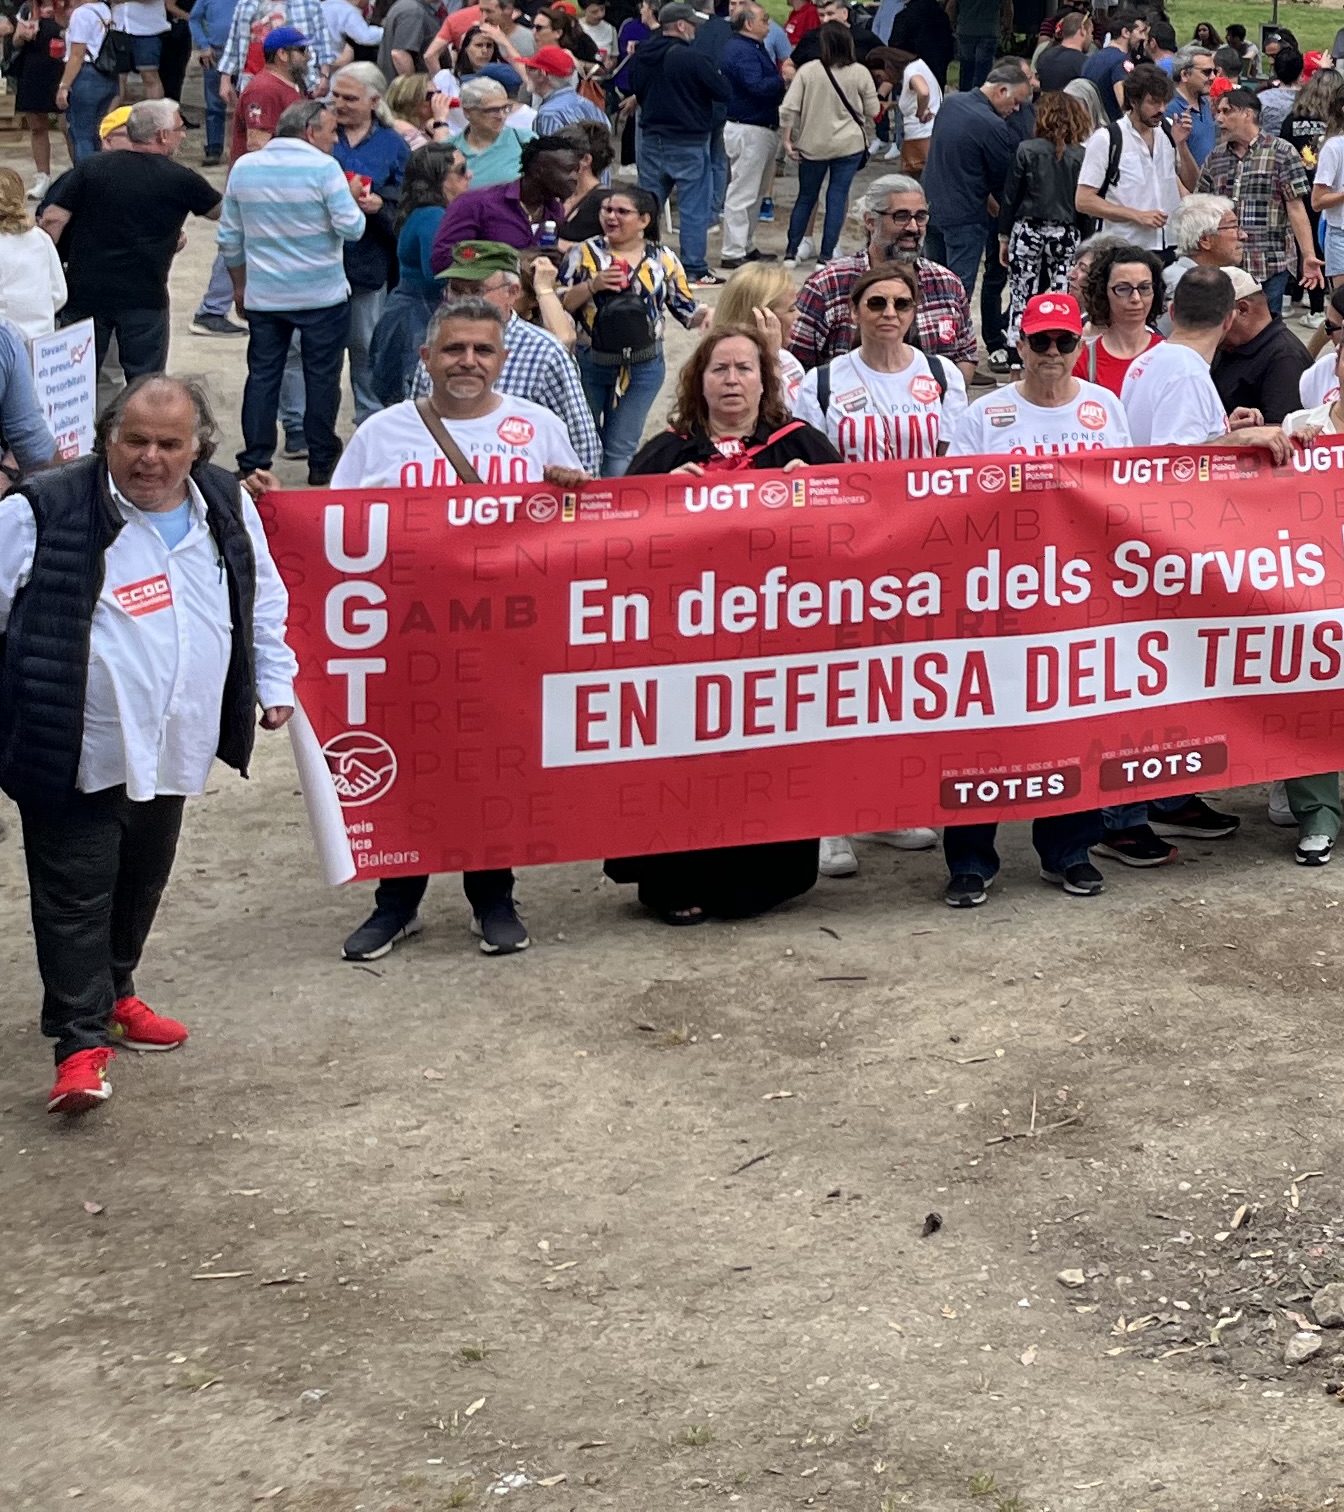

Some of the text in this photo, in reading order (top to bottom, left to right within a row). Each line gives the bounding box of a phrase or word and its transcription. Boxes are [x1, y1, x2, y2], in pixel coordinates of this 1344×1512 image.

[41, 342, 67, 359] Davant
[1061, 431, 1105, 443] PONES
[908, 468, 973, 497] UGT
[1113, 458, 1169, 484] UGT
[448, 496, 522, 526] UGT
[685, 483, 755, 512] UGT
[473, 533, 676, 582] ENTRE
[749, 522, 856, 561] PER
[921, 508, 1041, 550] AMB
[1105, 500, 1195, 536] PER
[117, 580, 168, 605] CCOO
[569, 578, 650, 646] En
[678, 565, 942, 638] defensa
[965, 545, 1092, 613] dels
[1112, 529, 1325, 599] Serveis
[325, 504, 388, 725] UGT
[400, 594, 538, 634] AMB
[575, 679, 658, 753] EN
[694, 650, 996, 743] DEFENSA
[1026, 631, 1169, 713] DELS
[1198, 620, 1344, 689] TEUS
[1122, 751, 1202, 782] TOTS
[954, 773, 1065, 804] TOTES
[358, 850, 419, 868] Balears
